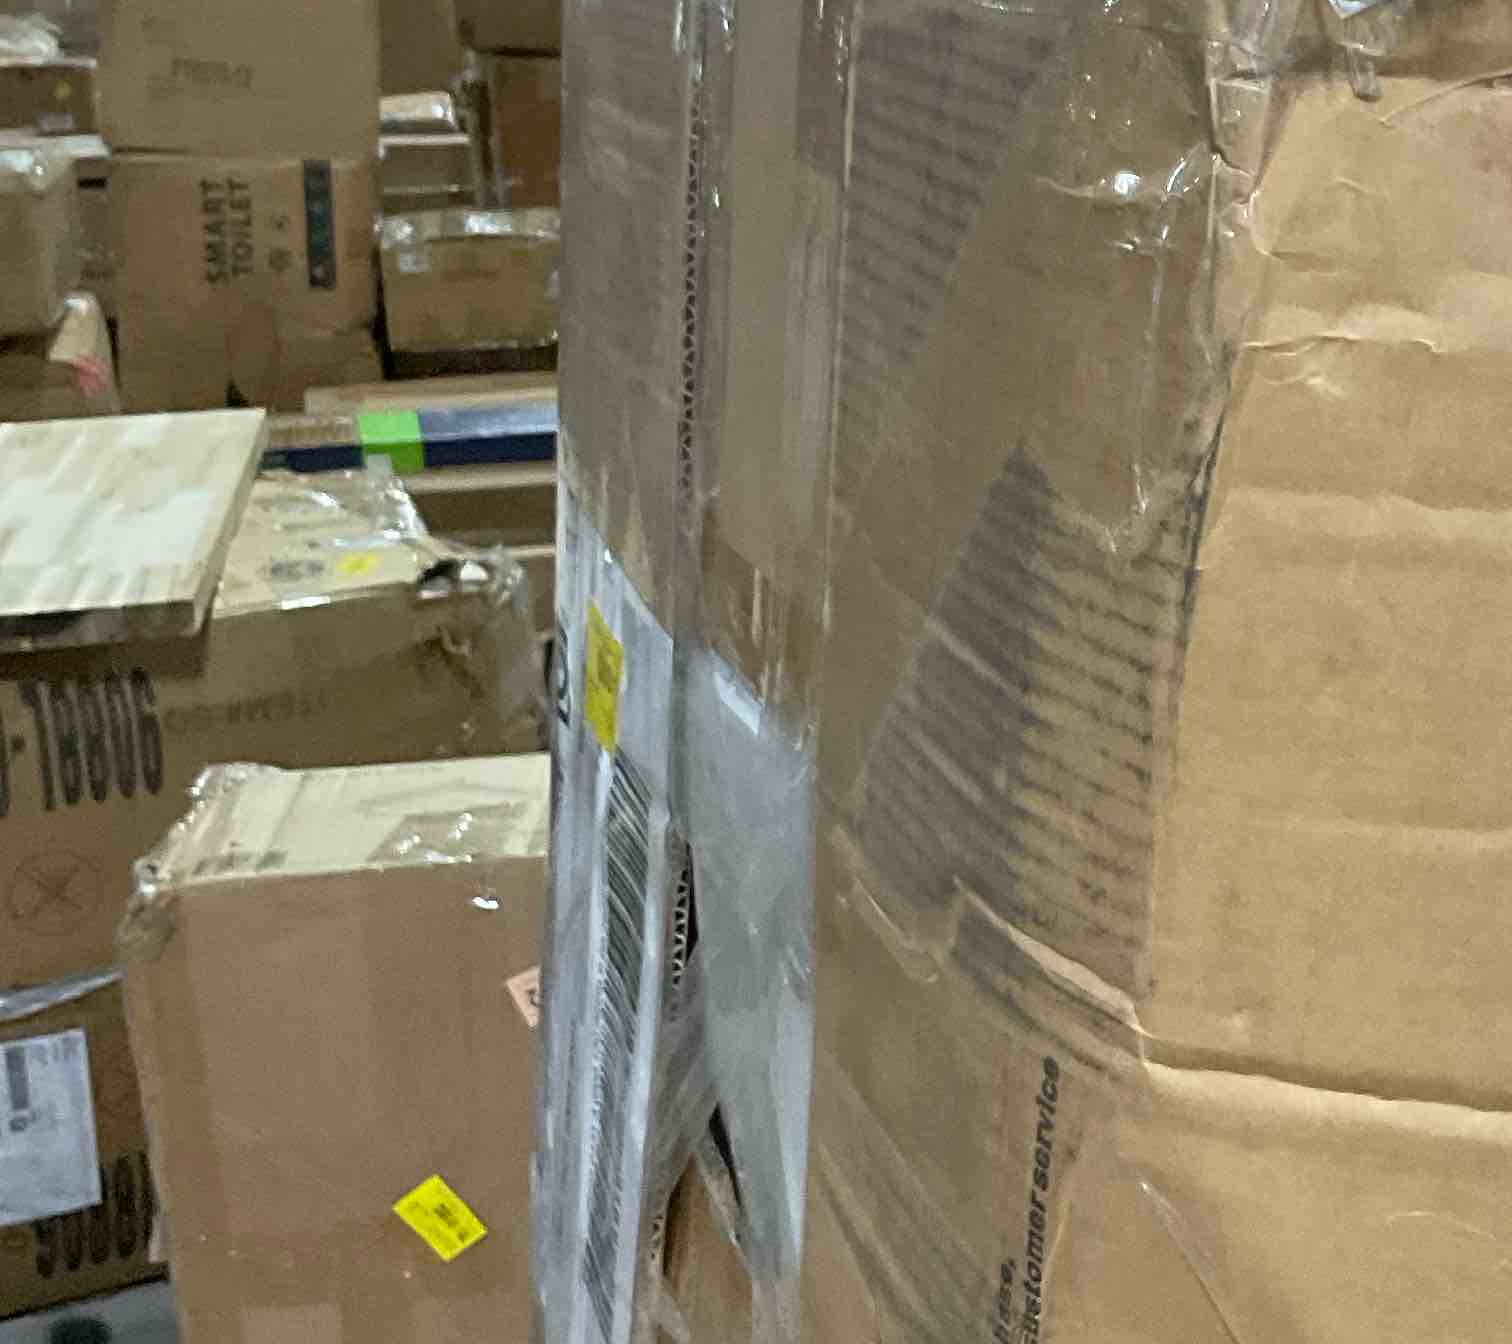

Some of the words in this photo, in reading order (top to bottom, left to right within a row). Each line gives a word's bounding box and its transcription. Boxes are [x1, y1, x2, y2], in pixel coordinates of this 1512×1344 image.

[201, 180, 231, 283] SMART
[229, 179, 253, 279] TOILET
[1027, 1055, 1060, 1192] service
